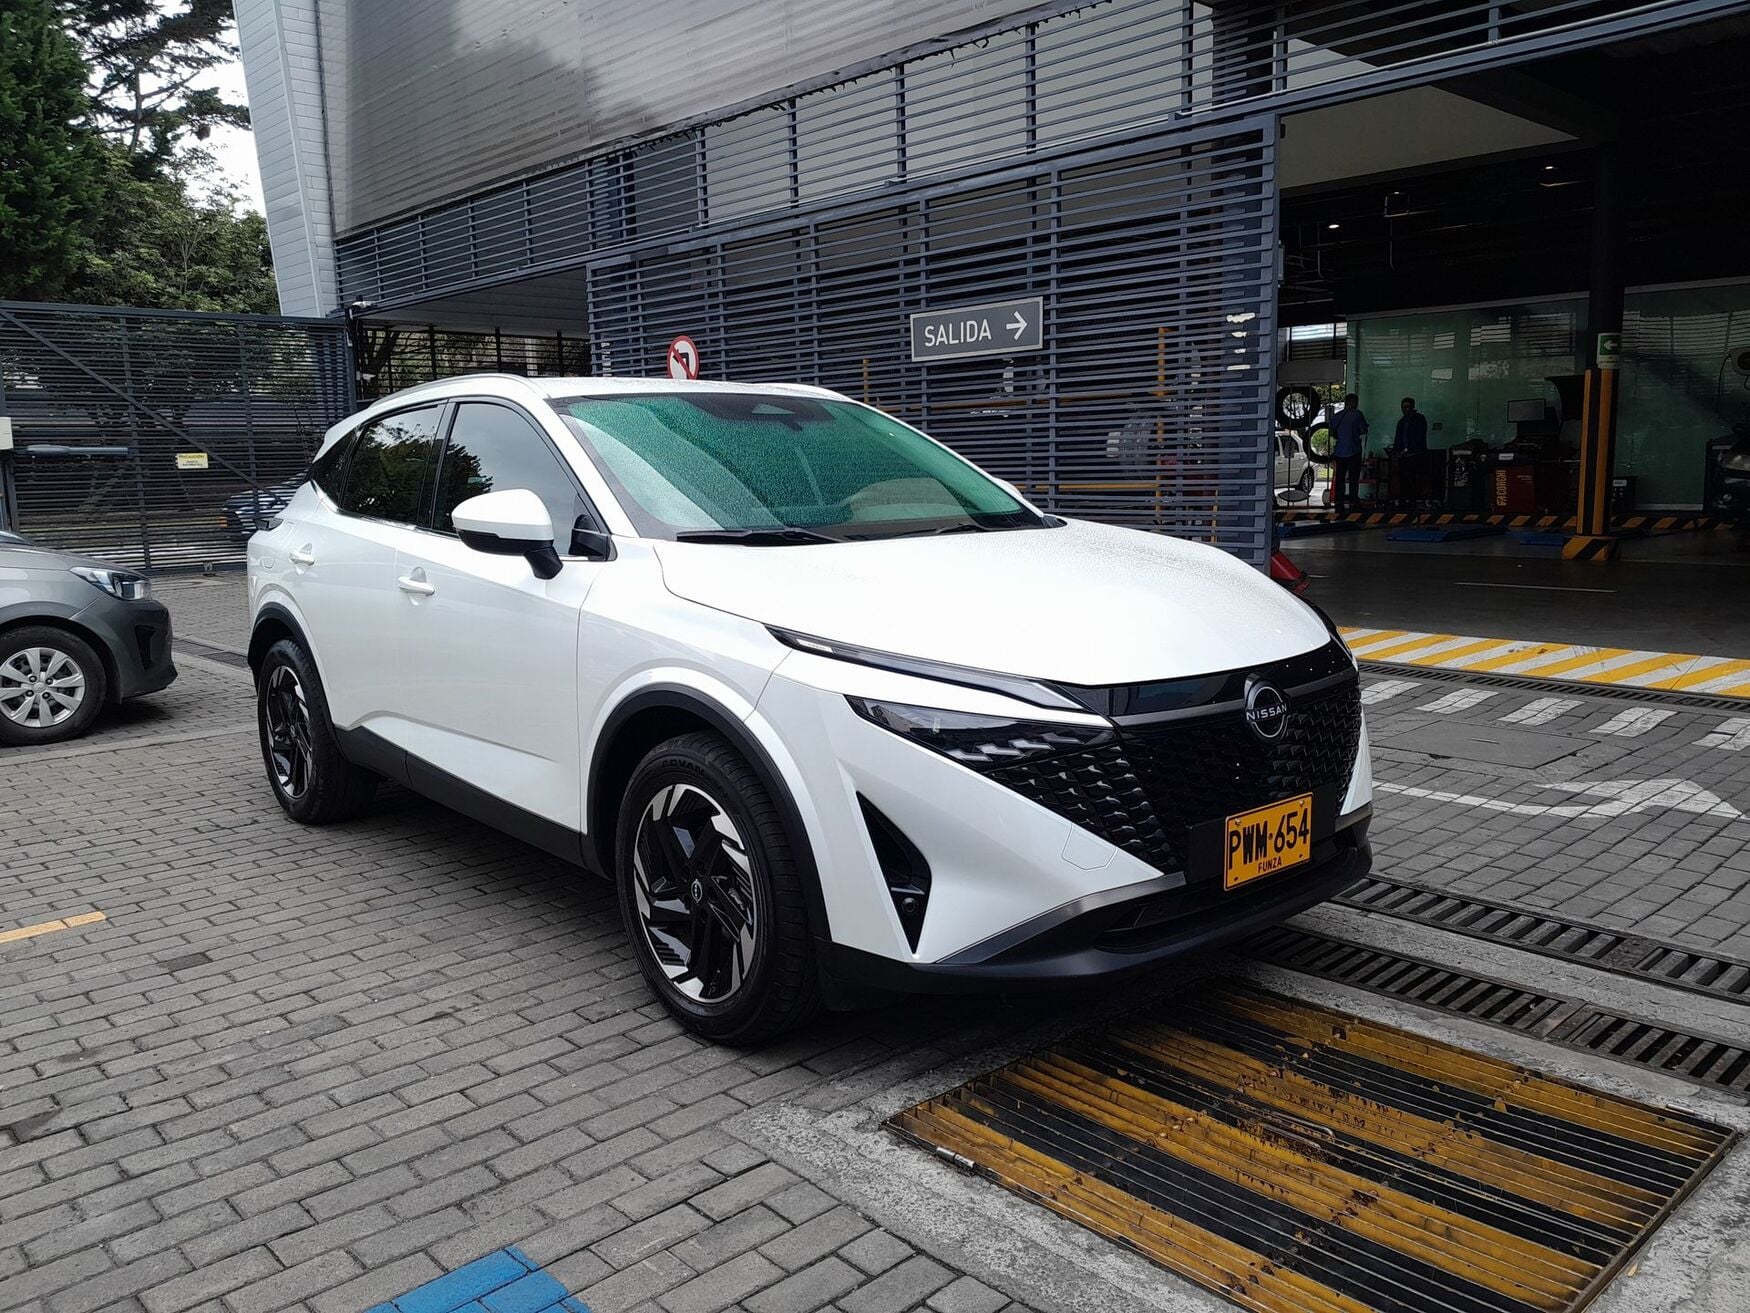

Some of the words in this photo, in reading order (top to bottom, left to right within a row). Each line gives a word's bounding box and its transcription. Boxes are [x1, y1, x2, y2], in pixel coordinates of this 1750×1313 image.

[924, 318, 992, 347] SALIDA
[1246, 703, 1287, 721] NISSAN
[1258, 856, 1282, 873] FUNZA
